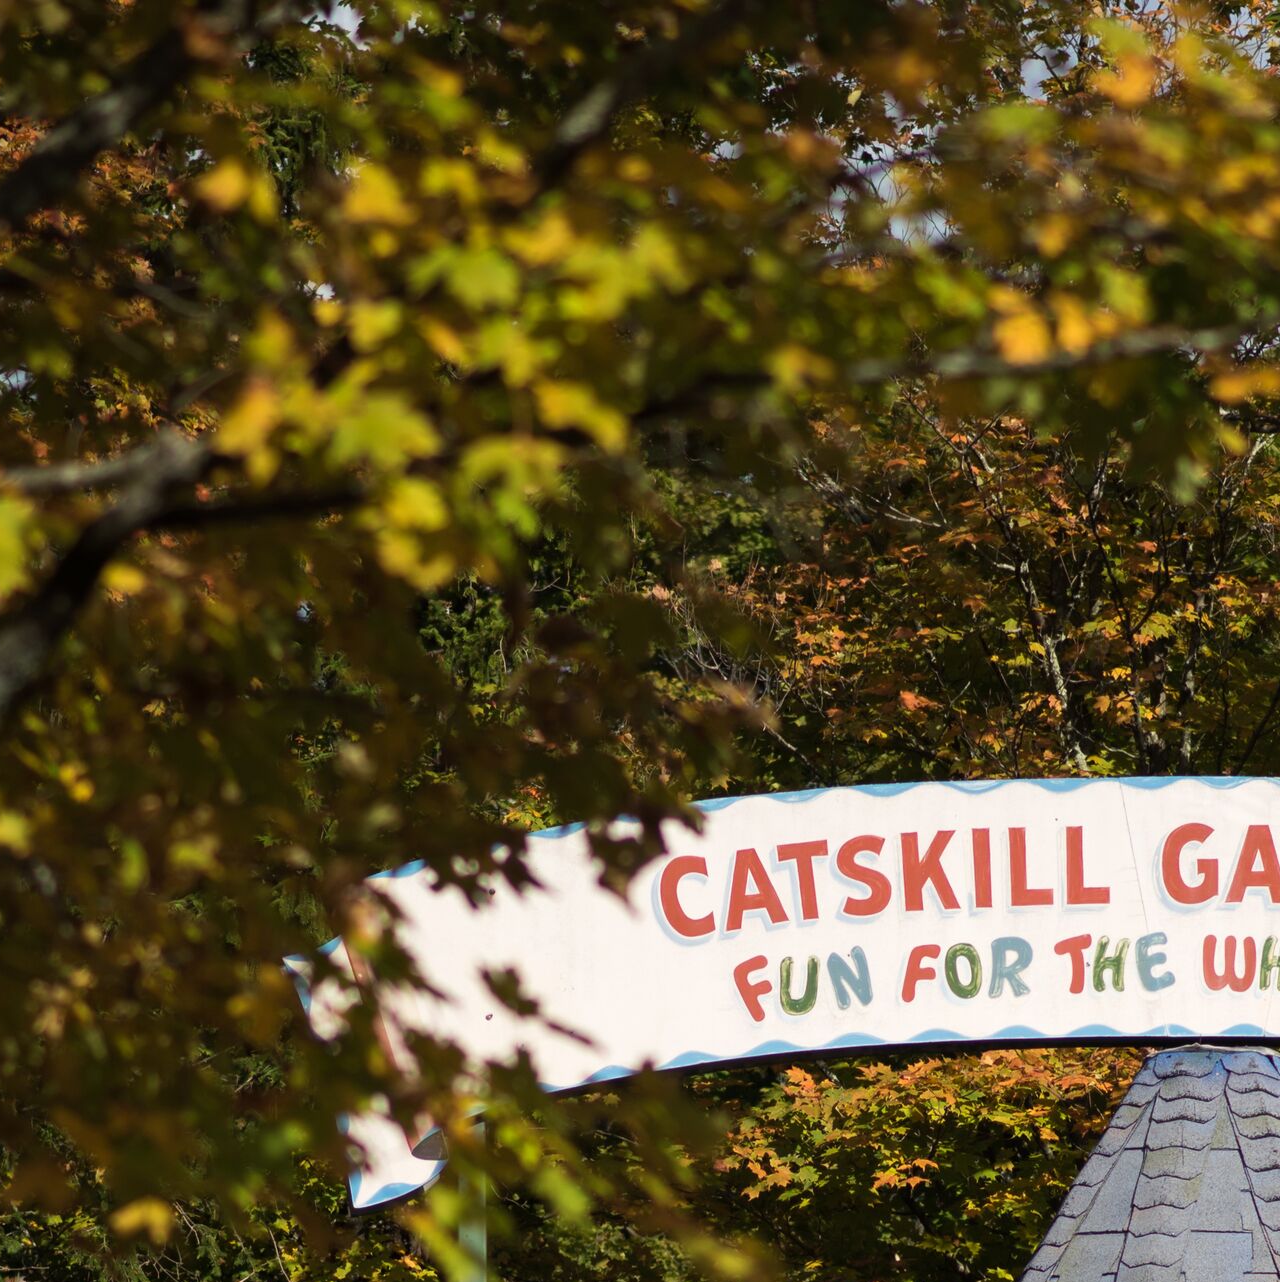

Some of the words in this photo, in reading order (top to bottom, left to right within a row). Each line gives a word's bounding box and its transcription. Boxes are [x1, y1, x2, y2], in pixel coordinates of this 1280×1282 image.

[659, 825, 1111, 938] CATSKILL
[733, 944, 873, 1022] FUN
[901, 935, 1033, 1003] FOR
[1054, 931, 1176, 994] THE
